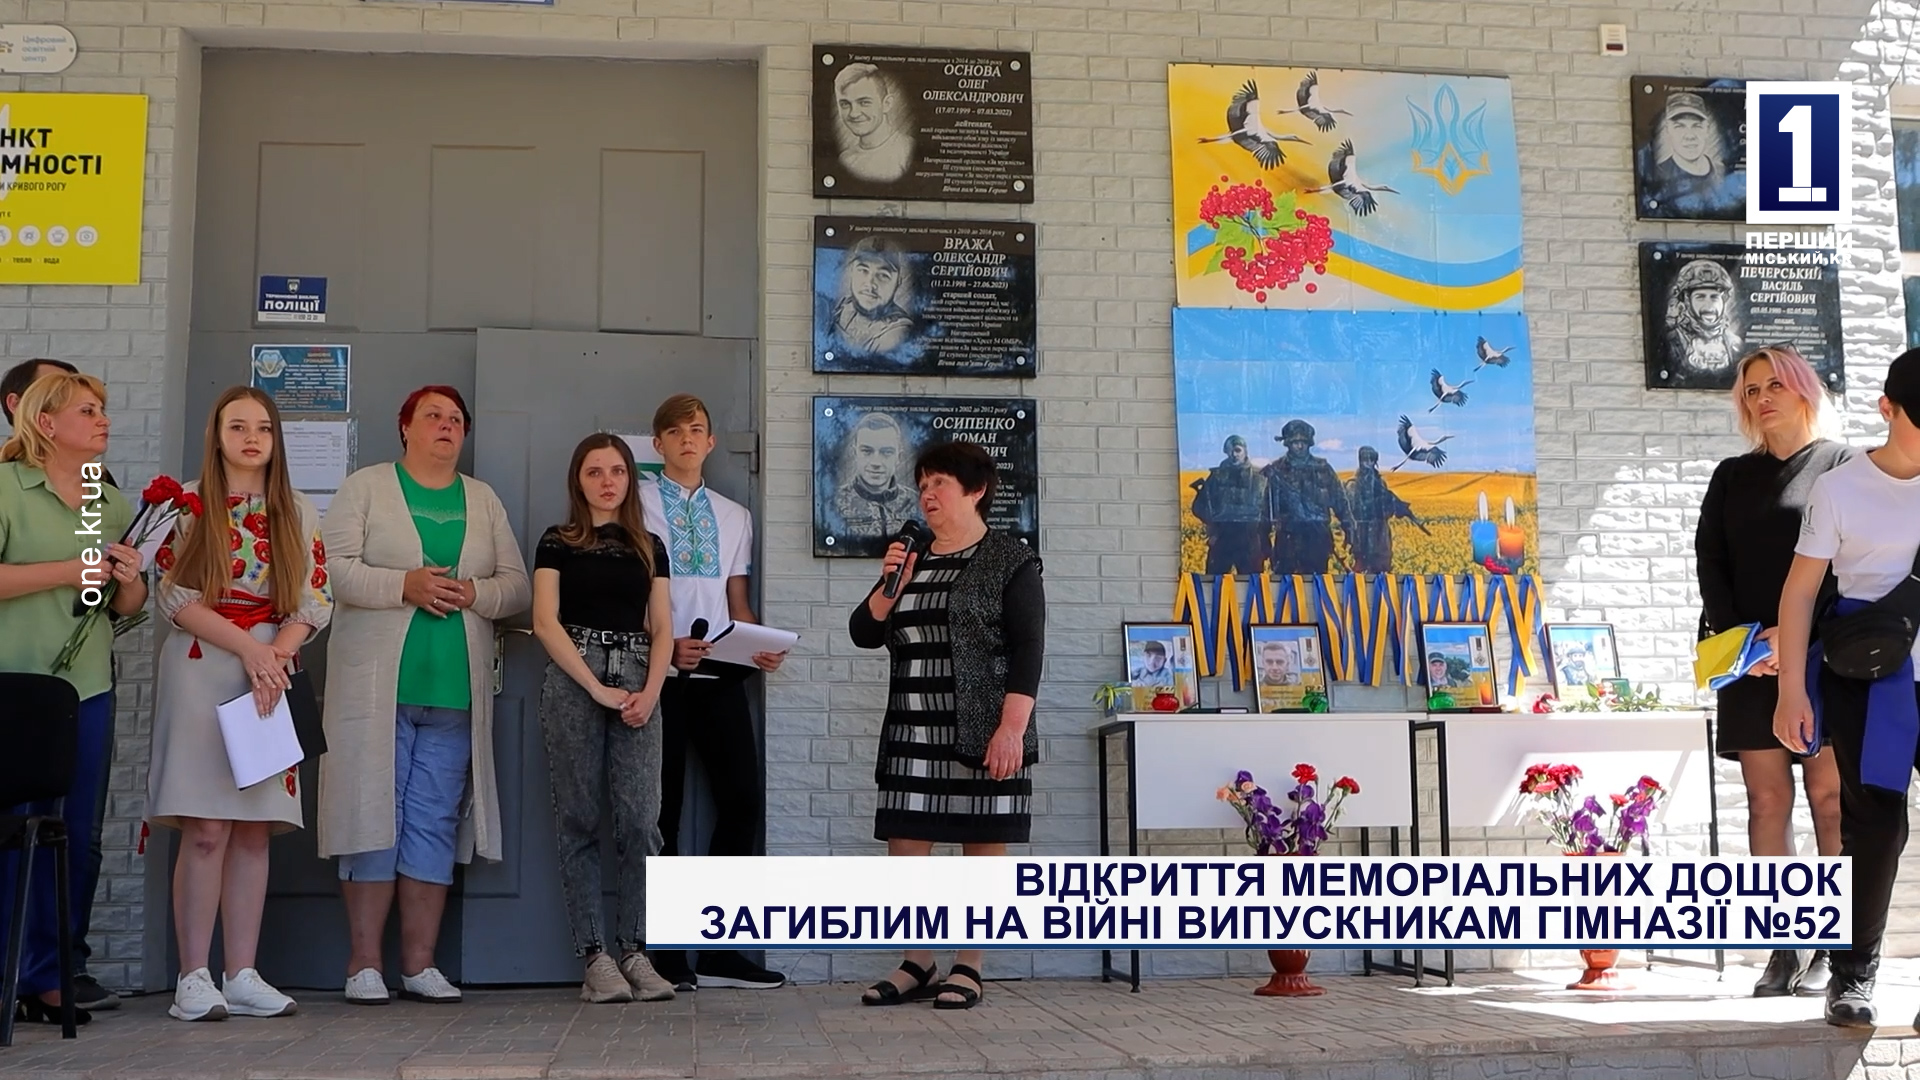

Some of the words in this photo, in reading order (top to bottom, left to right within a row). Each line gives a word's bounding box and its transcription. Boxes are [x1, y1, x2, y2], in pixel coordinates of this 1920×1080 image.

[943, 63, 1002, 77] ОСНОВА
[957, 79, 989, 90] ОЛЕГ
[922, 90, 1025, 104] ОЛЕКСАНДРОВИЧ
[0, 127, 53, 149] НКТ
[1, 154, 102, 176] МНОСТІ
[7, 182, 45, 191] КРИВОГО
[46, 182, 67, 192] РОГУ
[943, 237, 995, 251] ВРАЖА
[932, 251, 1007, 266] ОЛЕКСАНДР
[931, 264, 1009, 278] СЕРГІЙОВИЧ
[1739, 266, 1822, 281] ПЕЧЕРСЬКИЙ
[1761, 281, 1803, 291] ВАСИЛЬ
[1750, 292, 1817, 304] СЕРГІЙОВИЧ
[264, 299, 321, 313] ПОЛІЦІЇ
[932, 416, 1016, 431] ОСИПЕНКО
[951, 432, 998, 444] РОМАН
[983, 446, 1008, 458] ВИЧ
[996, 462, 1014, 472] 2023)
